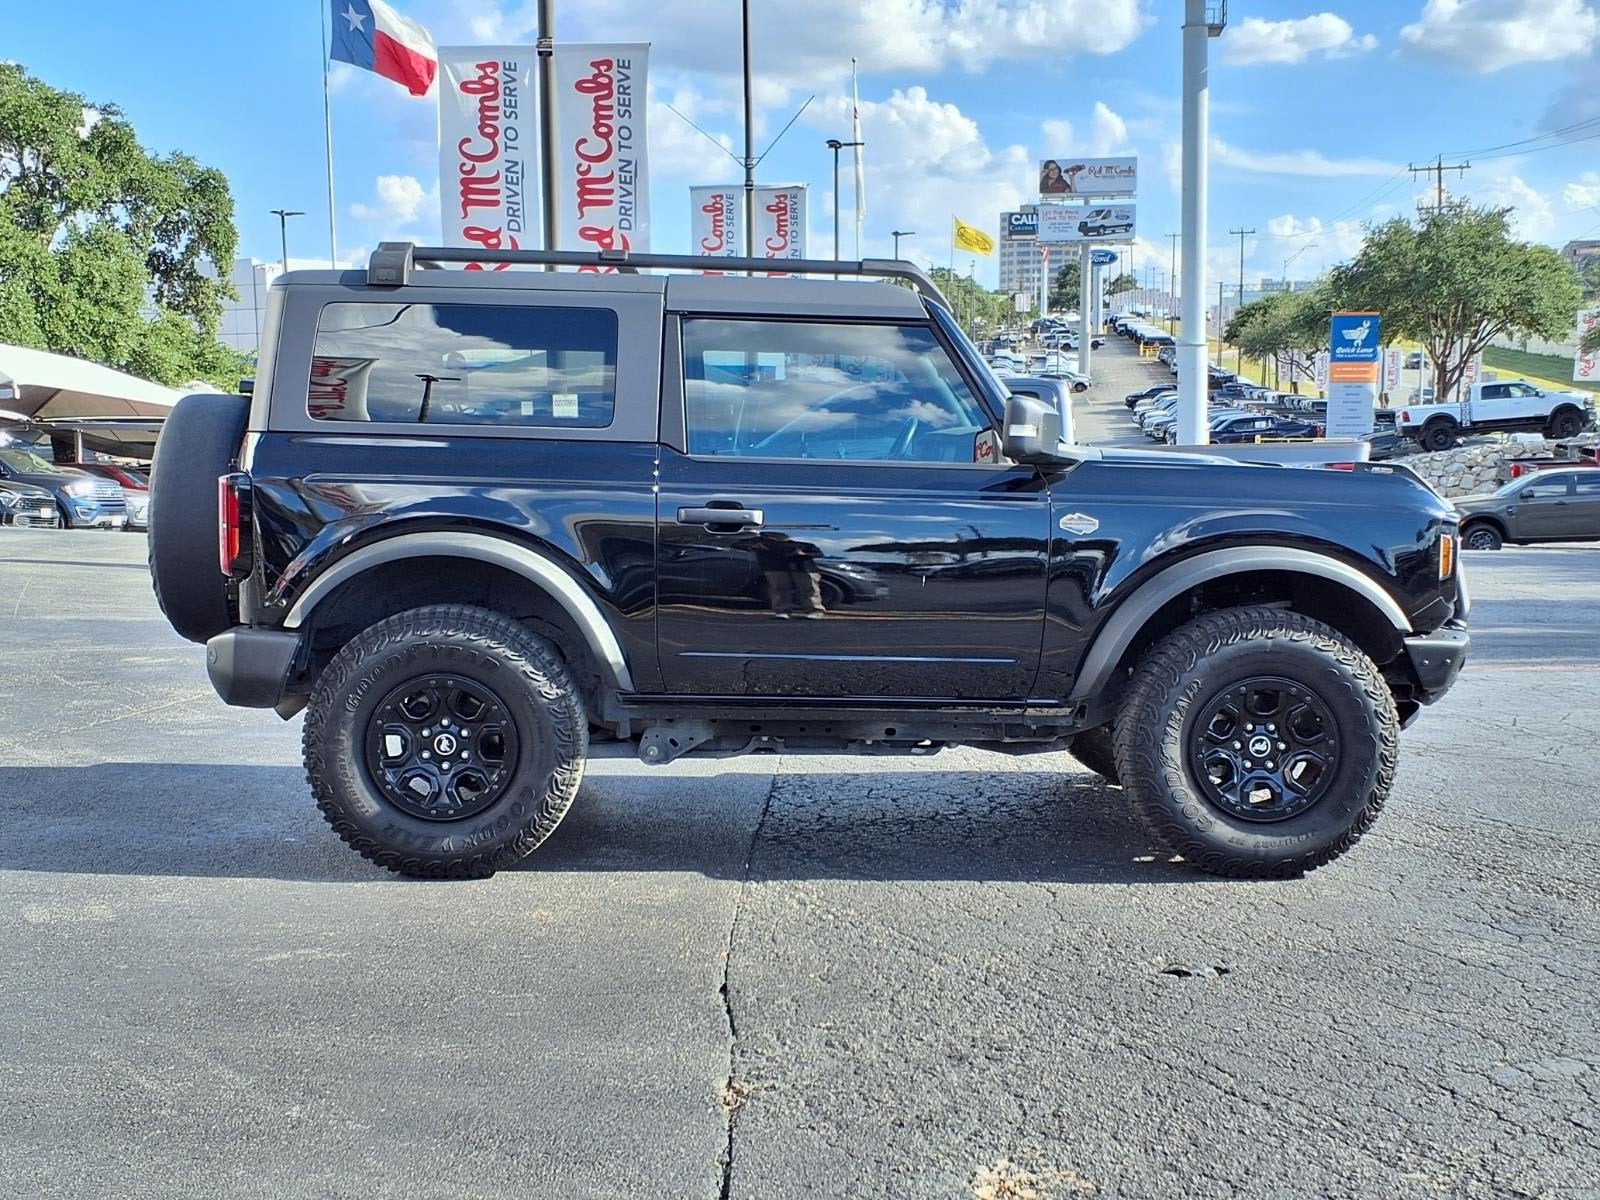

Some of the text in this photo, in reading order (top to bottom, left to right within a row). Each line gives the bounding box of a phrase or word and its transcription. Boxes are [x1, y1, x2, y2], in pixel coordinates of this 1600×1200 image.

[458, 61, 501, 219] McCombs
[503, 61, 521, 232] DRIVEN TO SERVE
[575, 58, 614, 219] McCombs
[617, 59, 632, 231] DRIVEN TO SERVE
[701, 194, 724, 276] cCombs
[726, 193, 734, 227] SERVE
[726, 231, 735, 245] TO
[766, 194, 788, 278] cCombs
[790, 193, 799, 227] SERVE
[790, 230, 799, 245] TO
